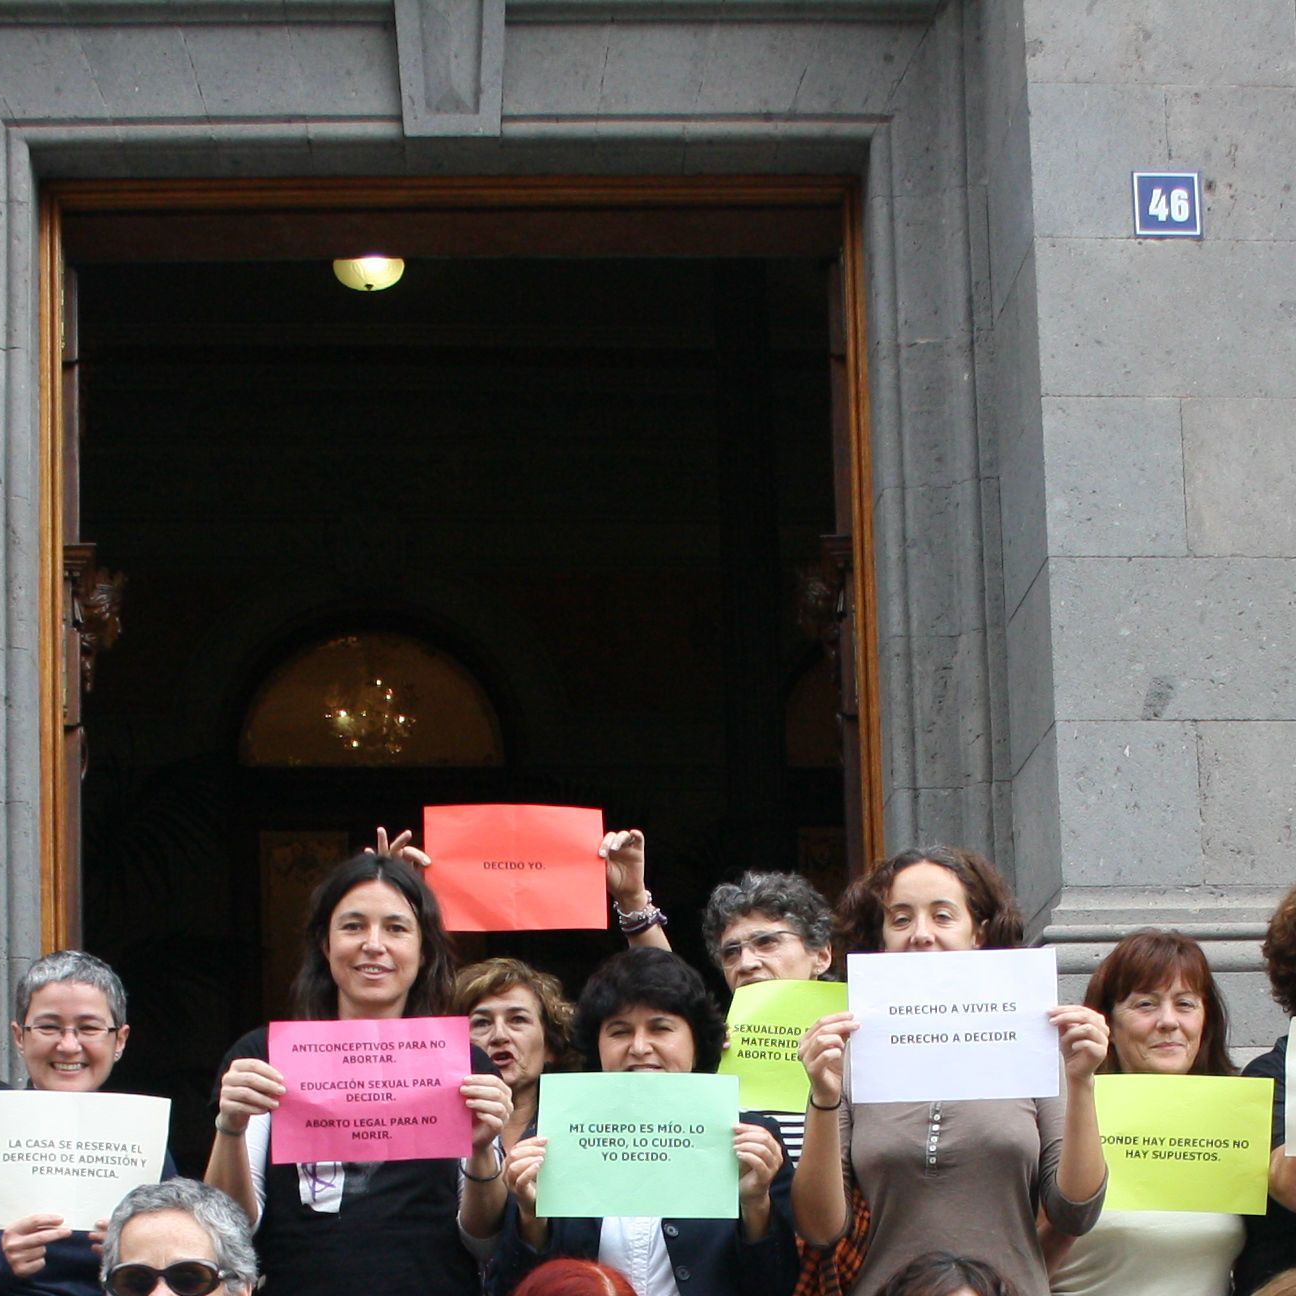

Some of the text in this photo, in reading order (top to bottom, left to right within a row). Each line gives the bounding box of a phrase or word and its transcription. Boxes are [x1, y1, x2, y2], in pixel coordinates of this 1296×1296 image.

[1149, 188, 1189, 222] 46
[484, 862, 546, 870] DECIDO YO.
[890, 1003, 1016, 1015] DERECHO A VIVIR ES
[734, 1024, 801, 1036] SEXUALIDAD
[741, 1037, 800, 1049] MATERNID
[891, 1032, 1016, 1044] DERECHO A DECIDIR
[292, 1042, 394, 1052] ANTICONCEPTIVOS
[399, 1041, 427, 1049] PARA
[343, 1055, 396, 1064] ABORTAR.
[738, 1050, 781, 1060] ABORTO
[301, 1078, 440, 1090] EDUCACIÓN SEXUAL PARA
[347, 1093, 396, 1102] DECIDIR.
[306, 1116, 437, 1128] ABORTO LEGAL PARA NO
[570, 1122, 704, 1134] MI CUERPO ES MÍO. LO
[352, 1131, 393, 1139] MORIR.
[9, 1139, 142, 1153] LA CASA SE RESERVA EL
[579, 1138, 694, 1149] QUIERO, LO CUIDO.
[1100, 1135, 1249, 1149] DONDE HAY DERECHOS NO
[3, 1153, 56, 1161] DERECHO
[61, 1154, 74, 1163] DE
[79, 1155, 137, 1166] ADMISIÓN
[602, 1152, 671, 1161] YO DECIDO.
[1126, 1150, 1221, 1161] HAY SUPUESTOS.
[32, 1166, 118, 1178] PERMANENCIA.
